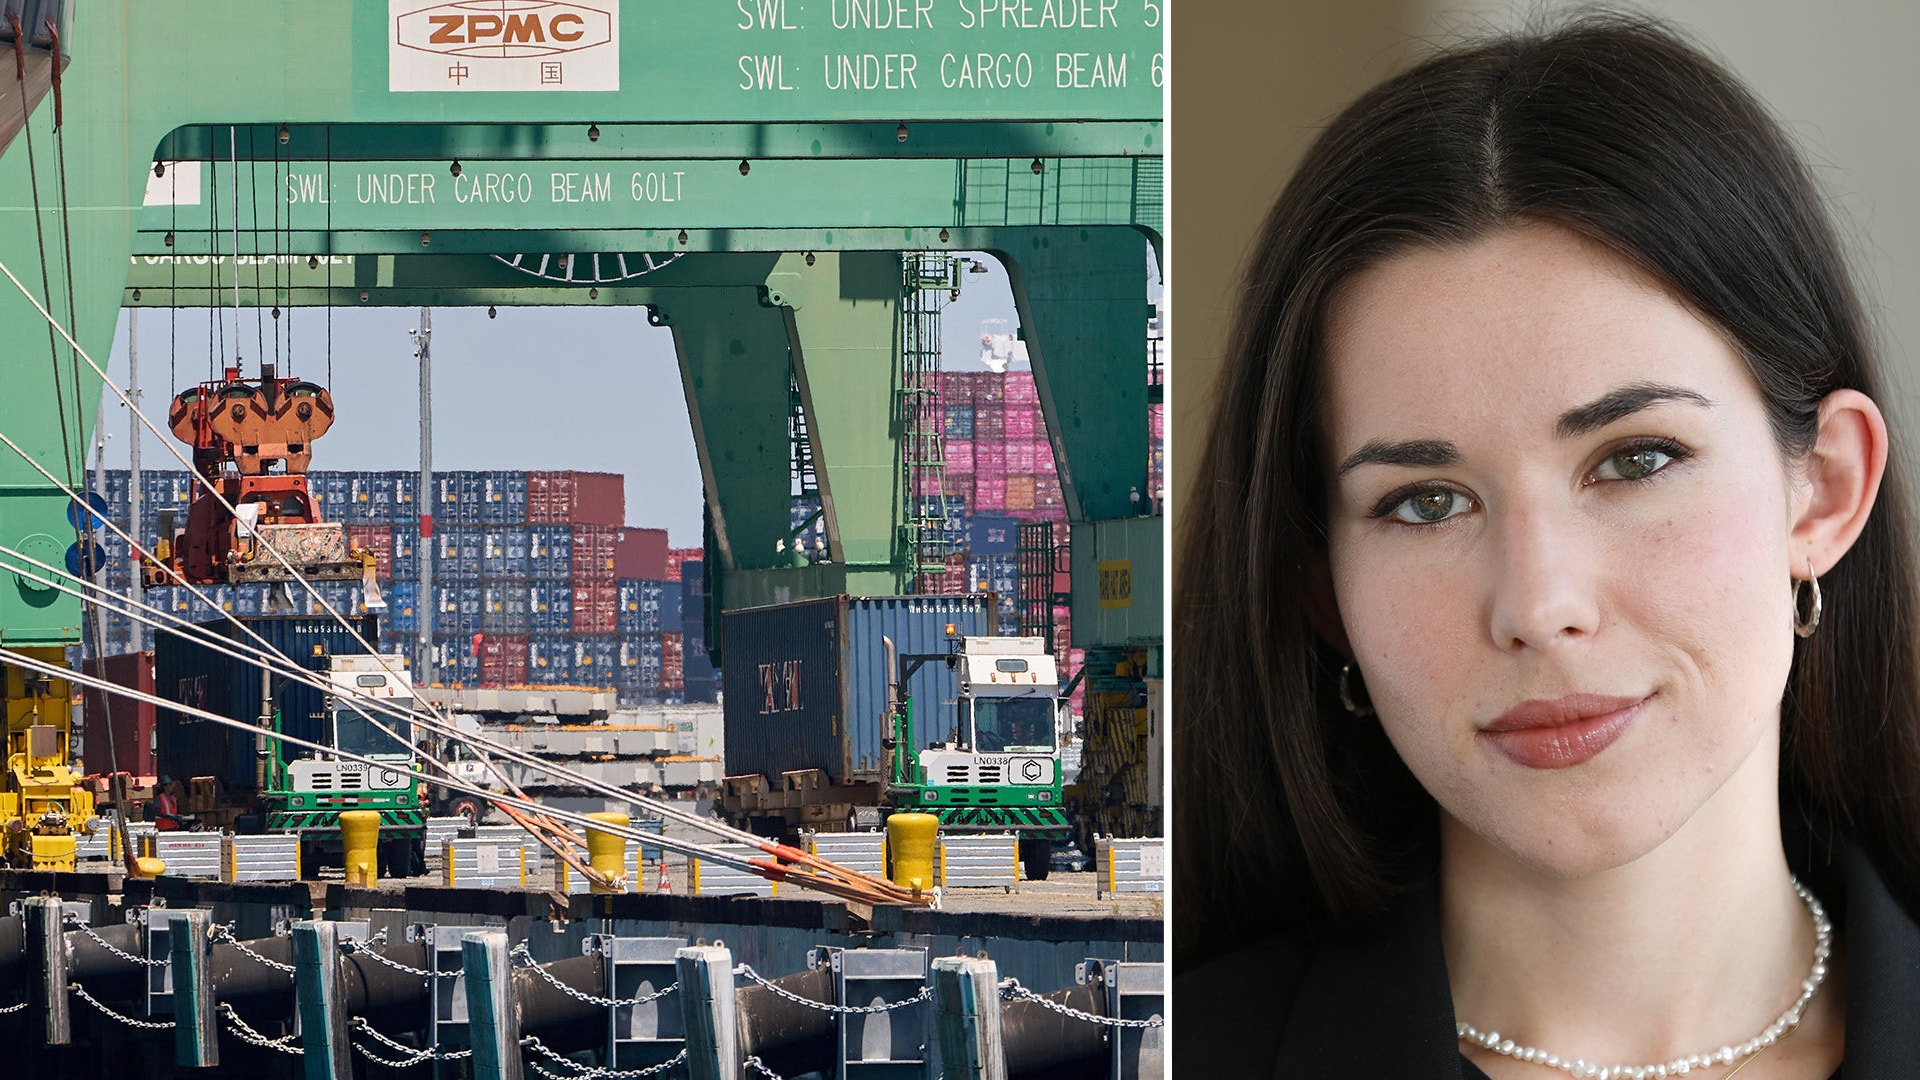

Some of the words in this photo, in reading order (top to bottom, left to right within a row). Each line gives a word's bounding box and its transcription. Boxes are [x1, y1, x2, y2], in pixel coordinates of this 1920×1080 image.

[429, 14, 584, 43] ZPMC
[738, 0, 804, 29] SWL:
[832, 0, 934, 29] UNDER
[960, 0, 1118, 28] SPREADER
[449, 61, 562, 85] 中国
[739, 55, 800, 90] SWL:
[824, 54, 918, 90] UNDER
[940, 53, 1032, 88] CARGO
[1056, 53, 1127, 88] BEAM
[286, 174, 337, 203] SWL:
[357, 174, 436, 203] UNDER
[454, 173, 532, 203] CARGO
[551, 173, 611, 202] BEAM
[631, 172, 685, 202] 60LT
[336, 763, 368, 772] LN0339
[973, 756, 1008, 765] LN0338
